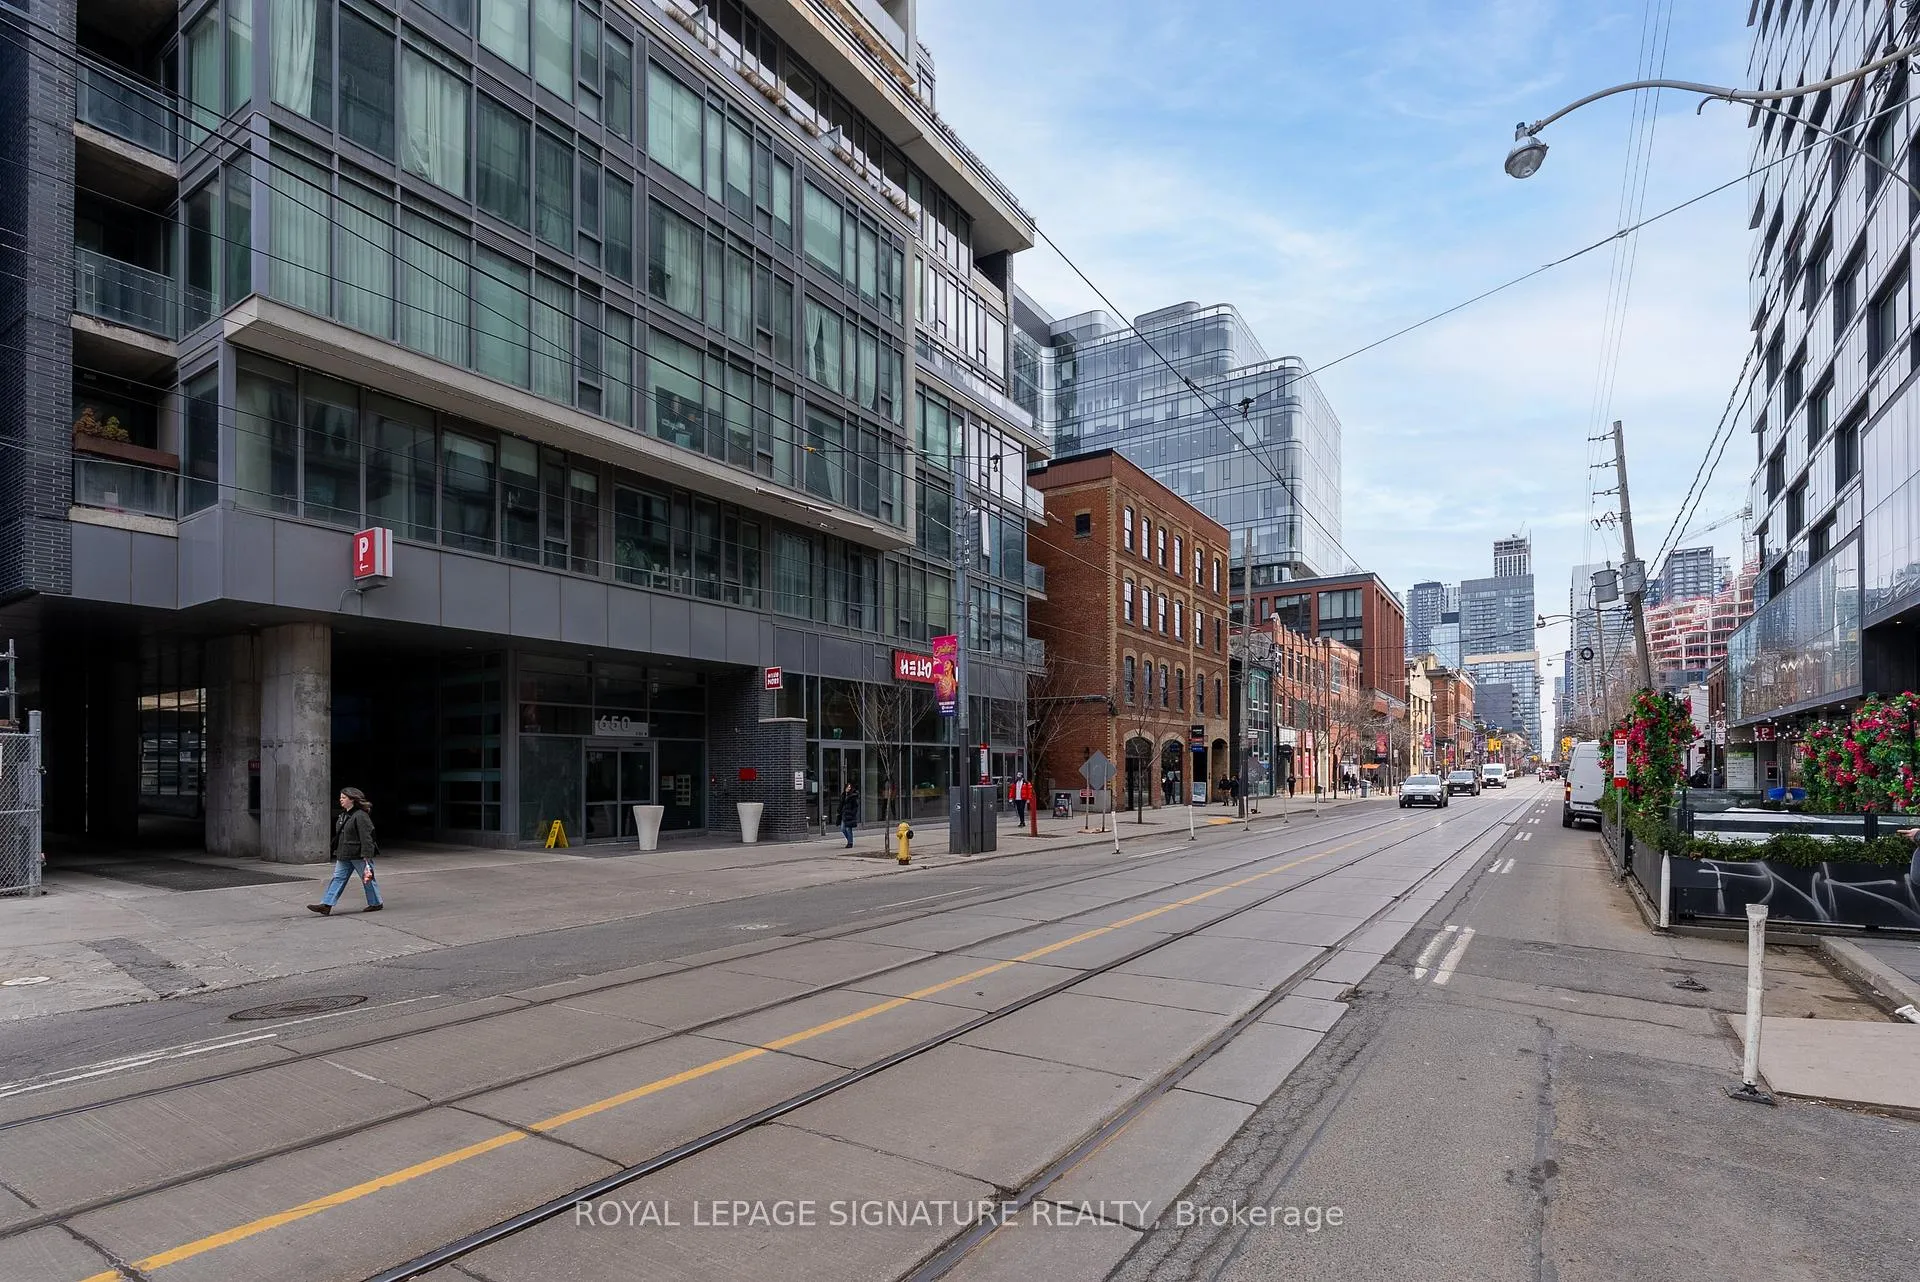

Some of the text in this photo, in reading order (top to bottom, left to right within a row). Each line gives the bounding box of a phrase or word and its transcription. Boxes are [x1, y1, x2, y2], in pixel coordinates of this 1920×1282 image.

[359, 537, 369, 562] P
[599, 715, 631, 731] 650
[1761, 727, 1769, 738] P
